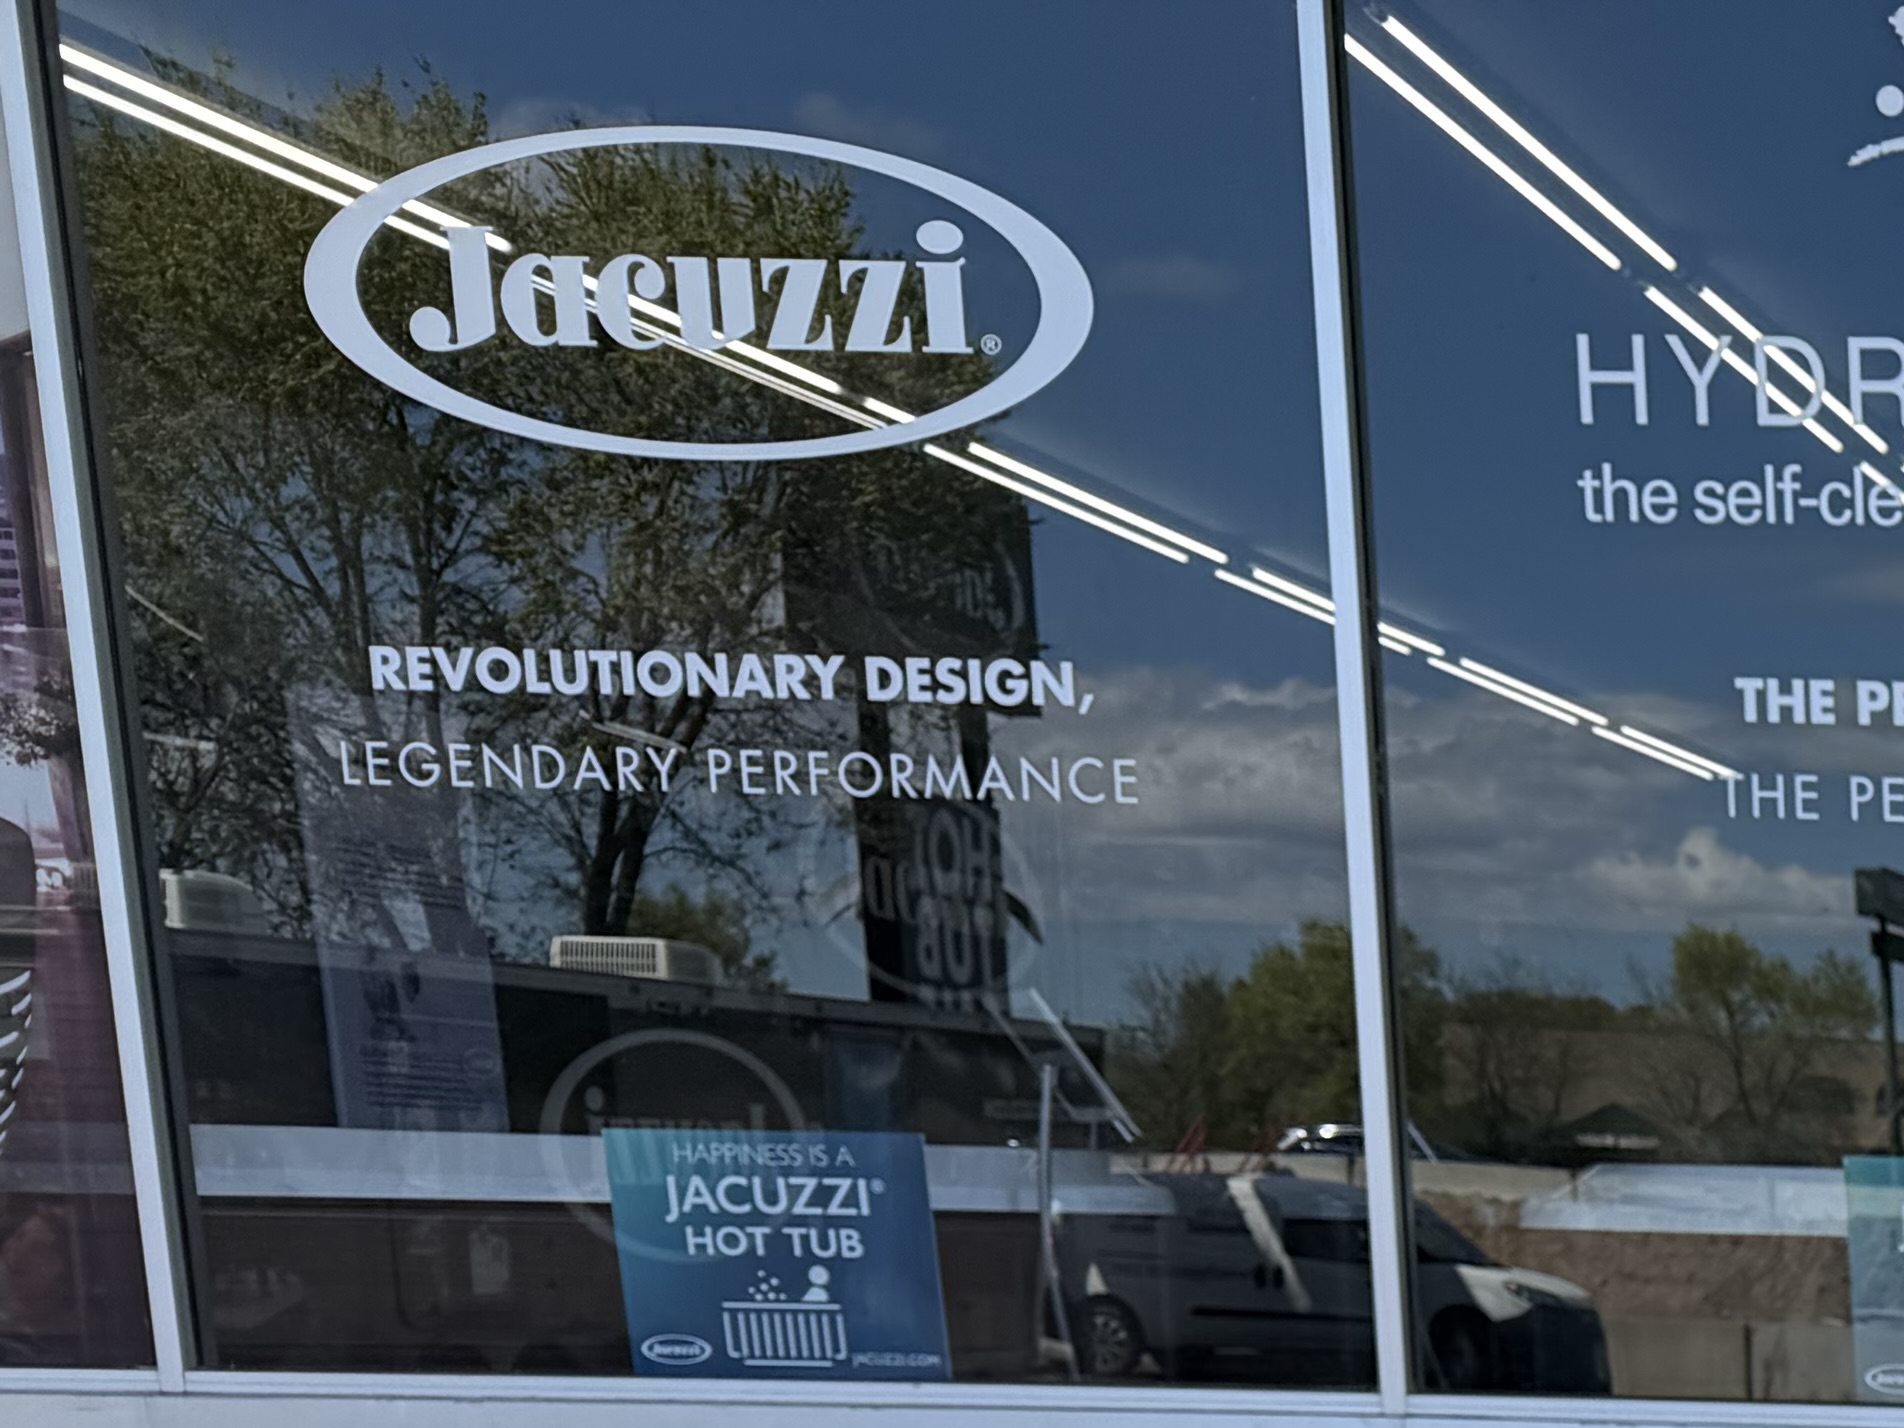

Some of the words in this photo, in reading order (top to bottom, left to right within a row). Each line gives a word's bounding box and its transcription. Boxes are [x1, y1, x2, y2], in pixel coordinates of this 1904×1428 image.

[1576, 462, 1678, 525] the
[368, 645, 845, 701] REVOLUTIONARY
[864, 655, 1096, 717] DESIGN,
[1734, 677, 1836, 725] THE
[339, 739, 680, 794] LEGENDARY
[707, 748, 1140, 806] PERFORMANCE
[1722, 774, 1820, 820] THE
[672, 1142, 803, 1168] HAPPINESS
[808, 1144, 829, 1168] IS
[835, 1146, 856, 1168] A
[685, 1225, 772, 1257] HOT
[781, 1227, 865, 1259] TUB
